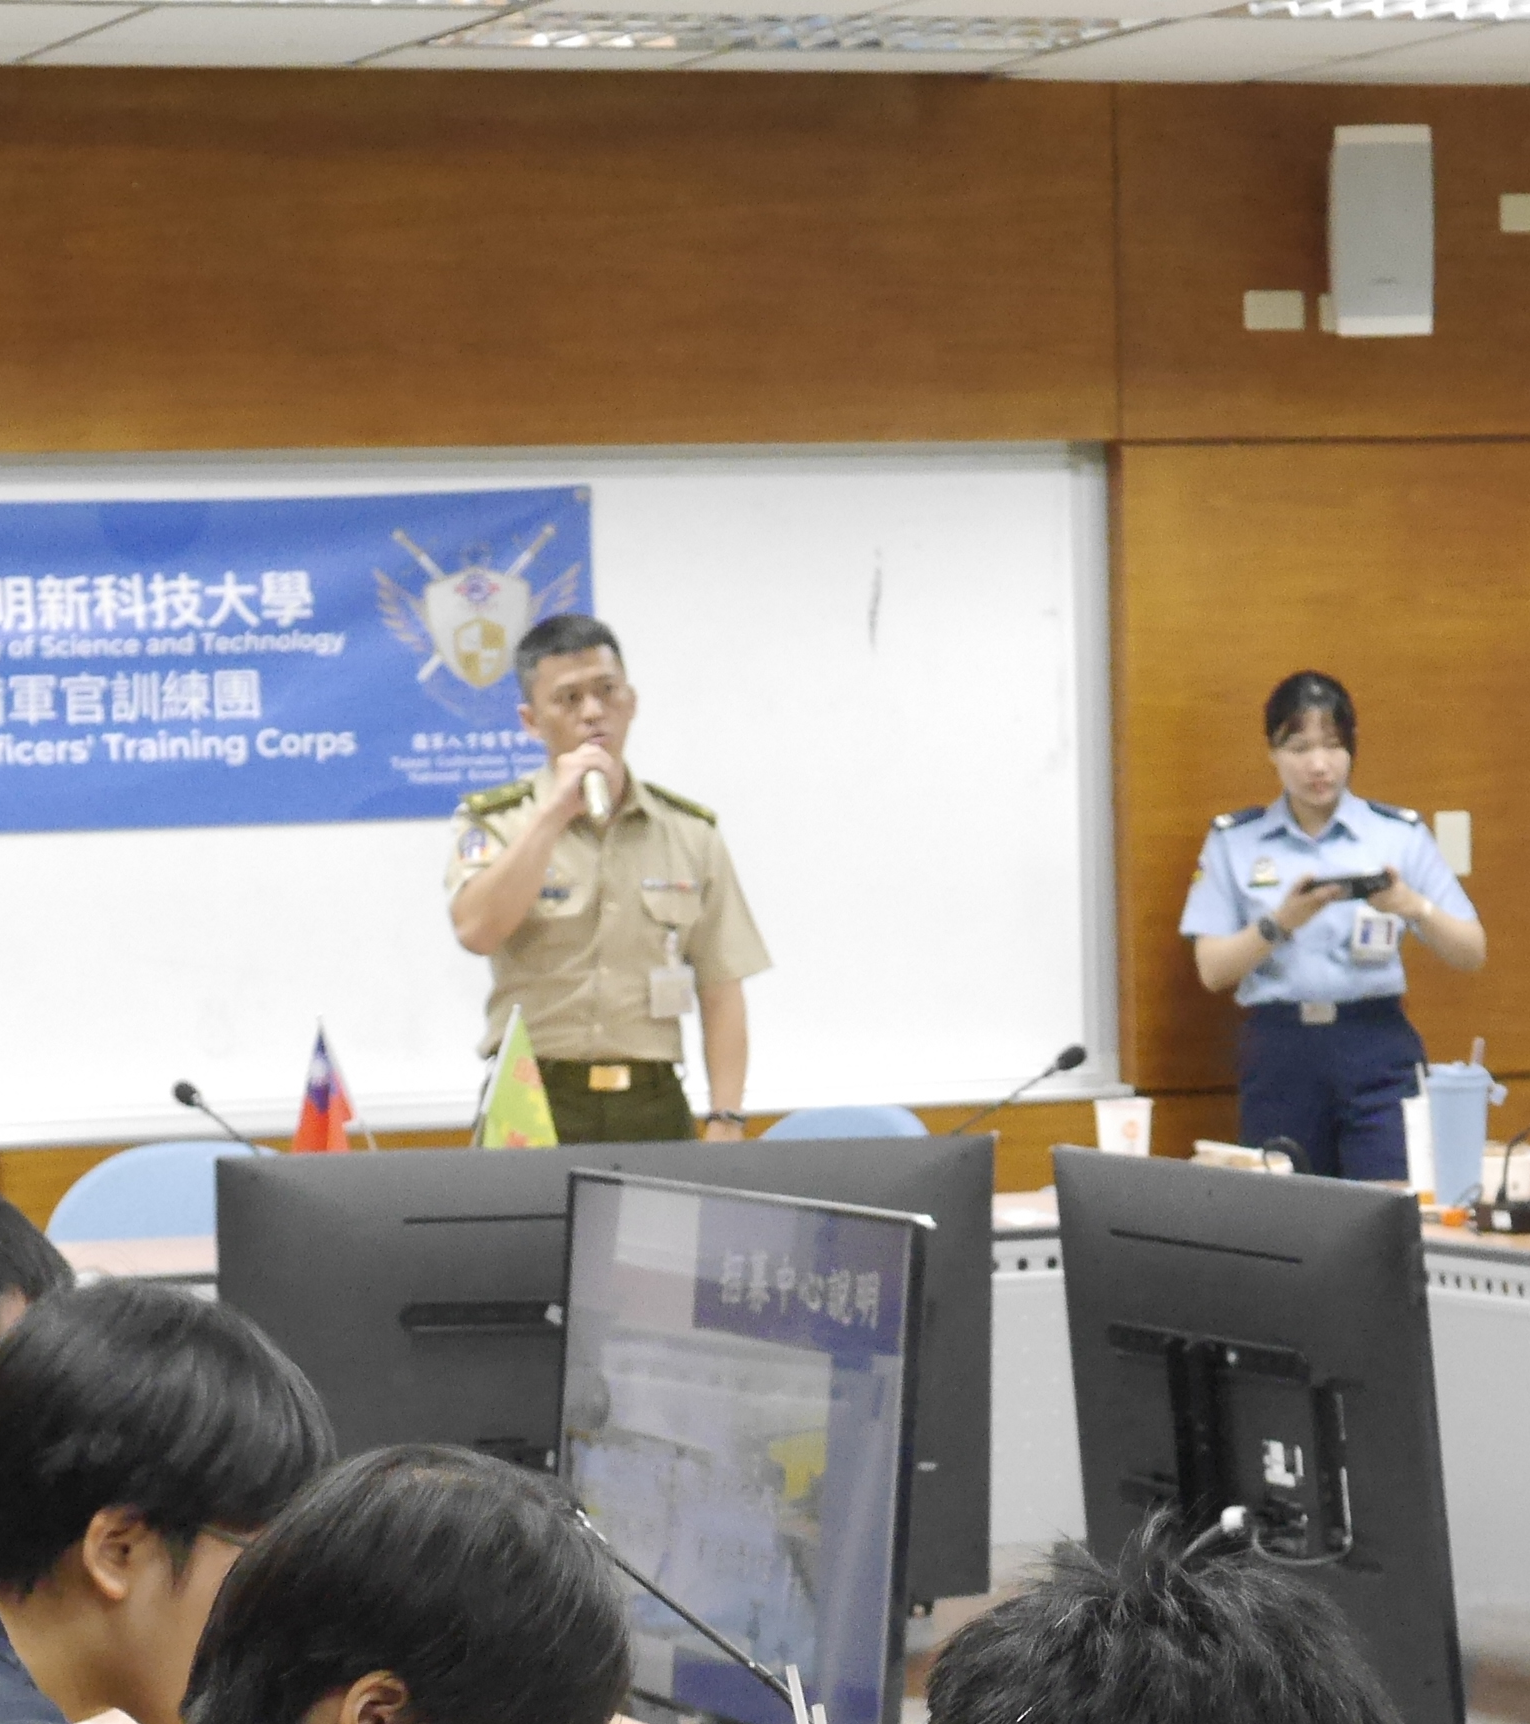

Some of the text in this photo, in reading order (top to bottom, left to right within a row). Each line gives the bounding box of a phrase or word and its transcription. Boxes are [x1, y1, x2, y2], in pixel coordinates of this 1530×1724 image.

[7, 634, 36, 659] of
[39, 633, 141, 660] Science
[145, 632, 197, 656] and
[200, 629, 346, 657] Technology
[100, 728, 249, 767] Training
[255, 726, 358, 764] Corps
